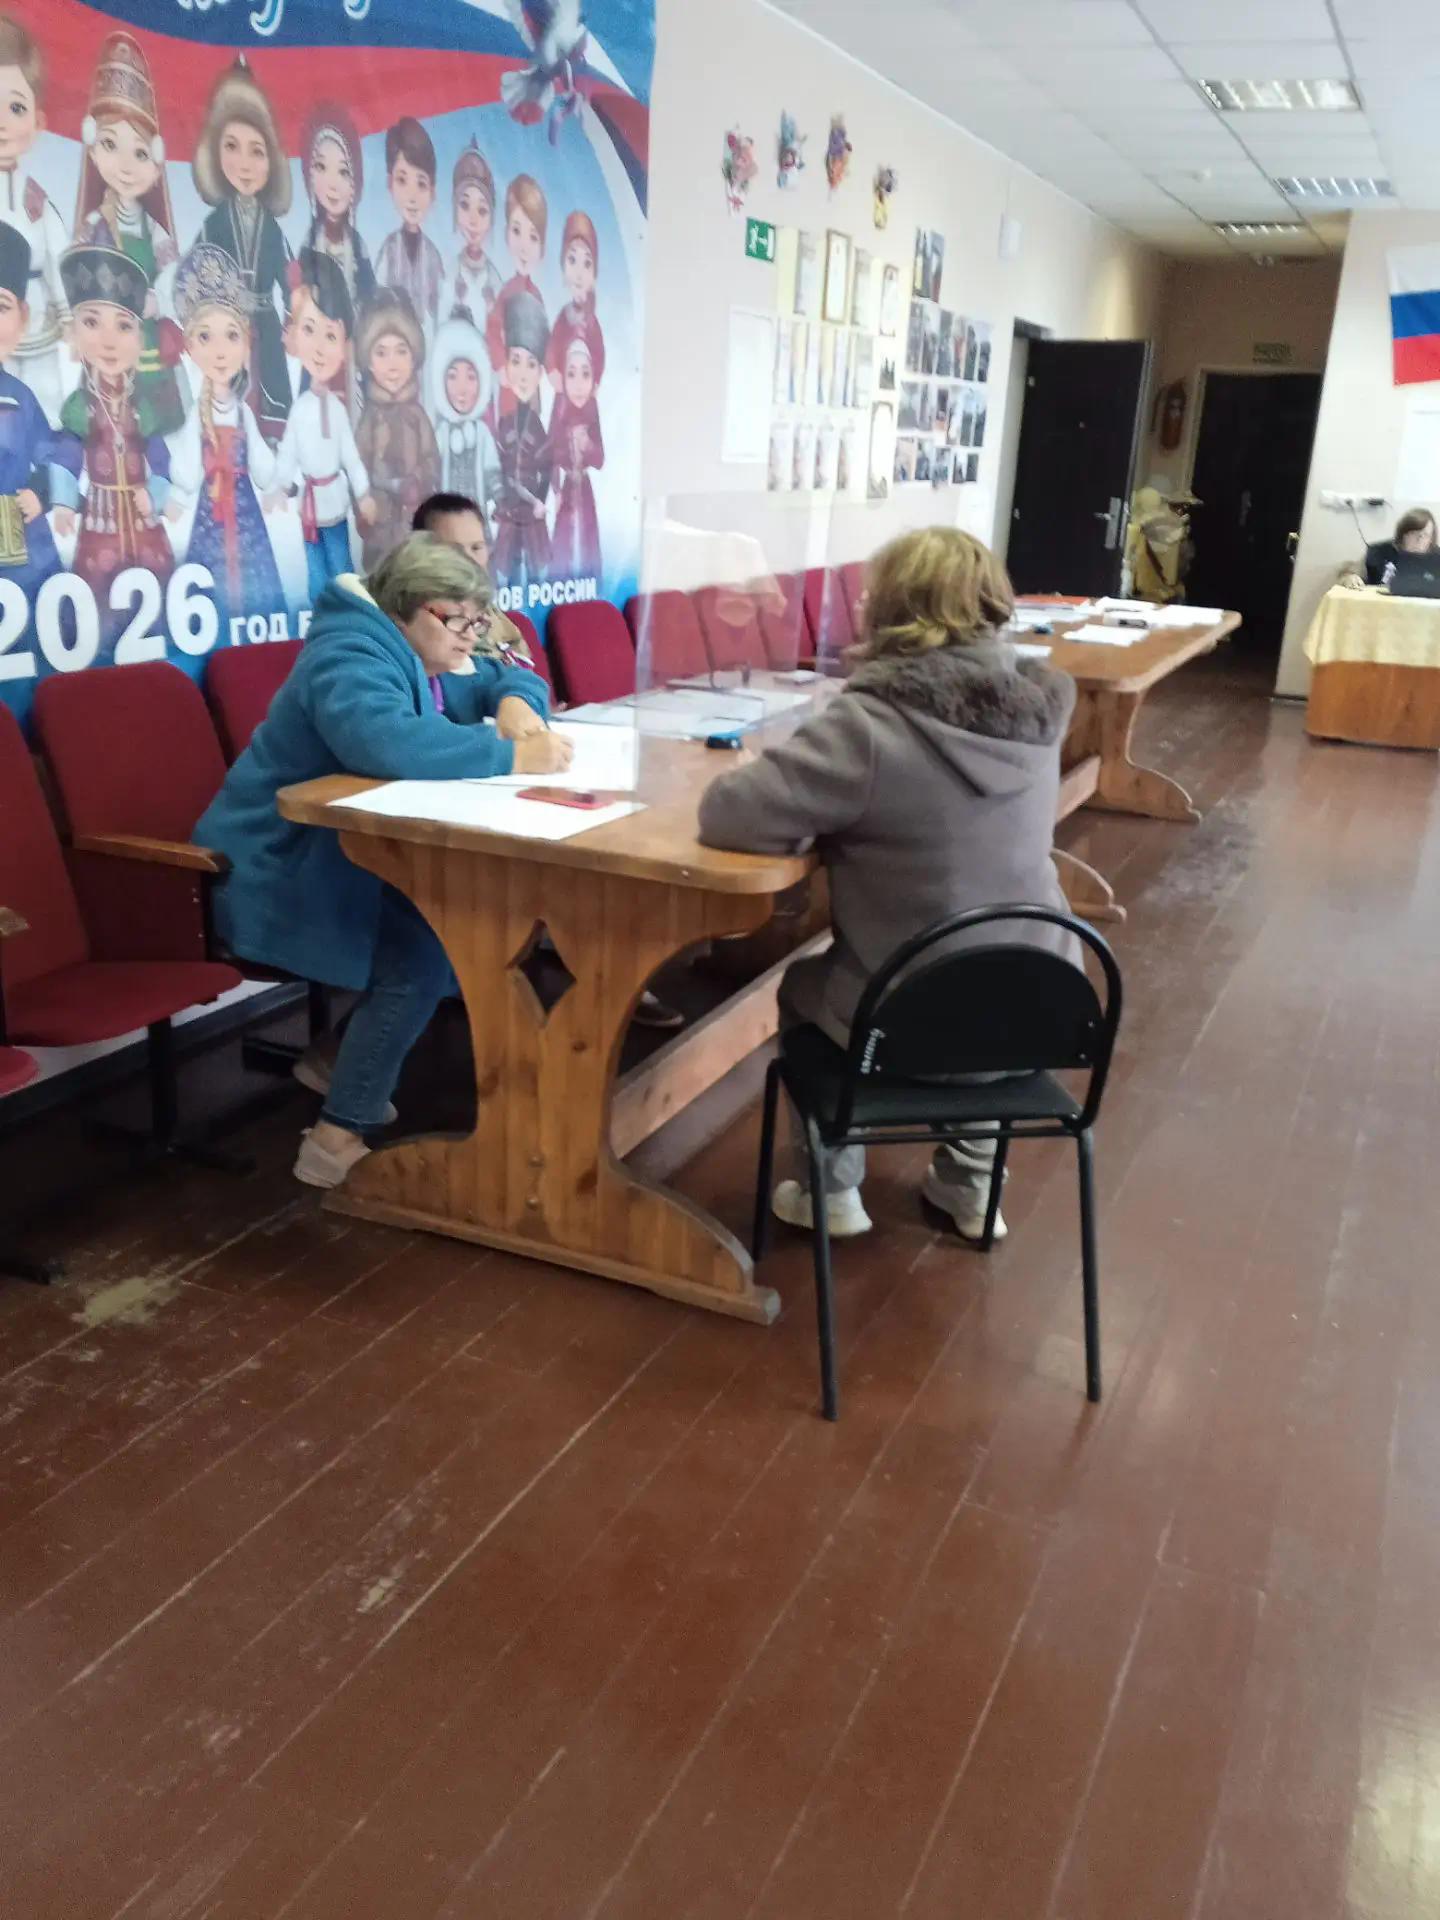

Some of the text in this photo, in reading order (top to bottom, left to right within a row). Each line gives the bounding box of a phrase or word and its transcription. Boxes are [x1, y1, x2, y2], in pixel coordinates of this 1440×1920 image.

[0, 563, 218, 681] 2026
[229, 613, 289, 647] ГОД
[528, 577, 597, 608] РОССИИ
